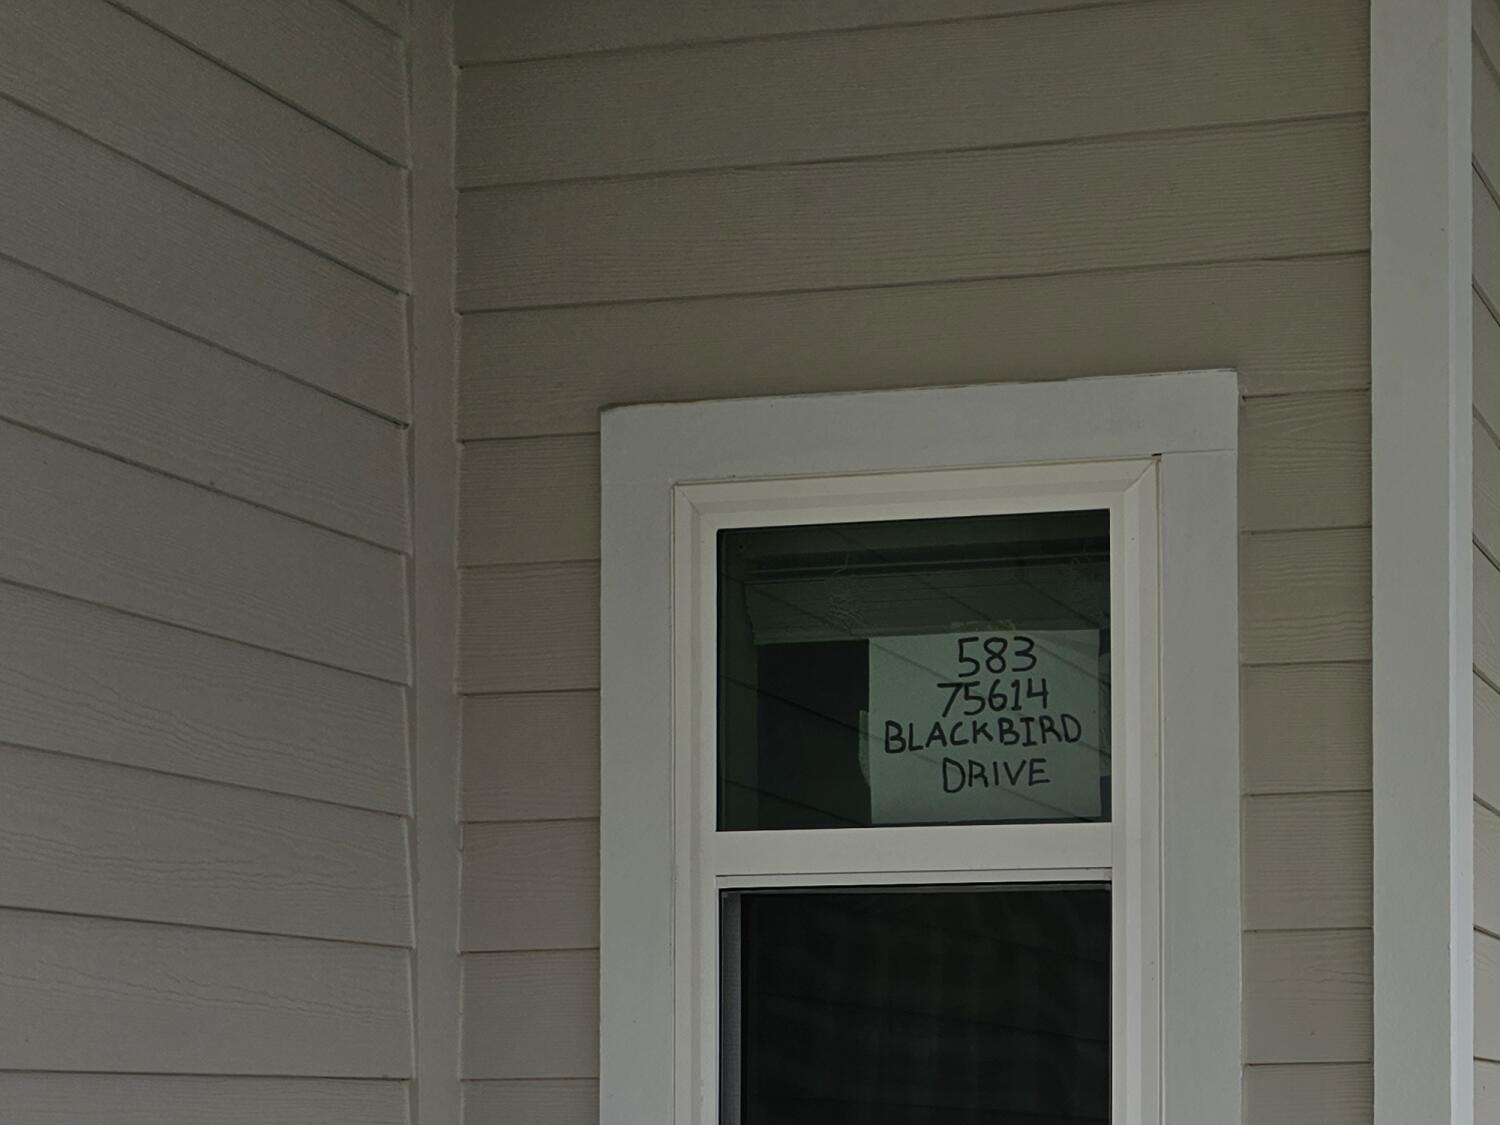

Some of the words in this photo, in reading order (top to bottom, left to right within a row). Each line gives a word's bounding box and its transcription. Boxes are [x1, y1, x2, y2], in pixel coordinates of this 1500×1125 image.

[957, 636, 1037, 678] 583
[937, 678, 1049, 718] 75614
[884, 713, 1082, 754] BLACKBIRD
[942, 757, 1050, 794] DRIVE
